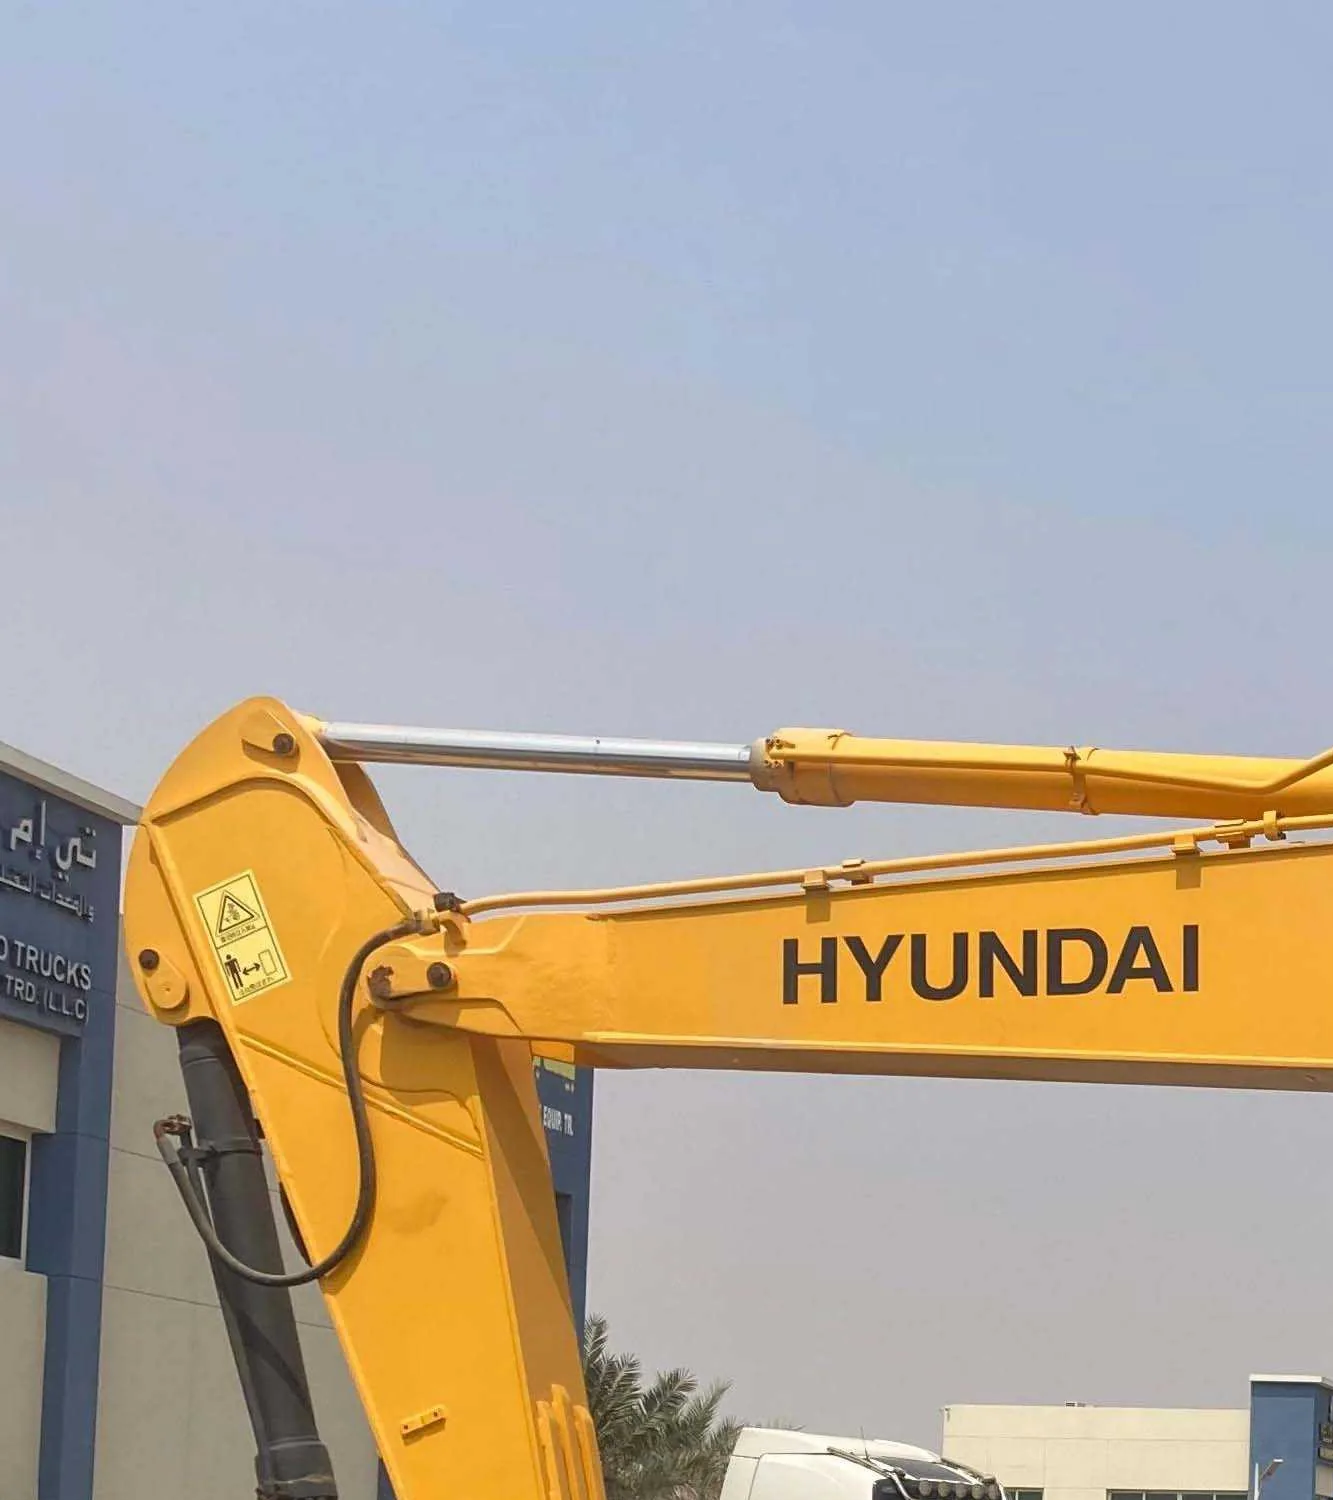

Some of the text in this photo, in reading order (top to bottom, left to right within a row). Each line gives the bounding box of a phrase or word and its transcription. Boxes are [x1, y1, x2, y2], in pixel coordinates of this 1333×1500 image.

[5, 974, 39, 1004] TRD.
[14, 939, 92, 991] TRUCKS
[782, 924, 1199, 1005] HYUNDAI
